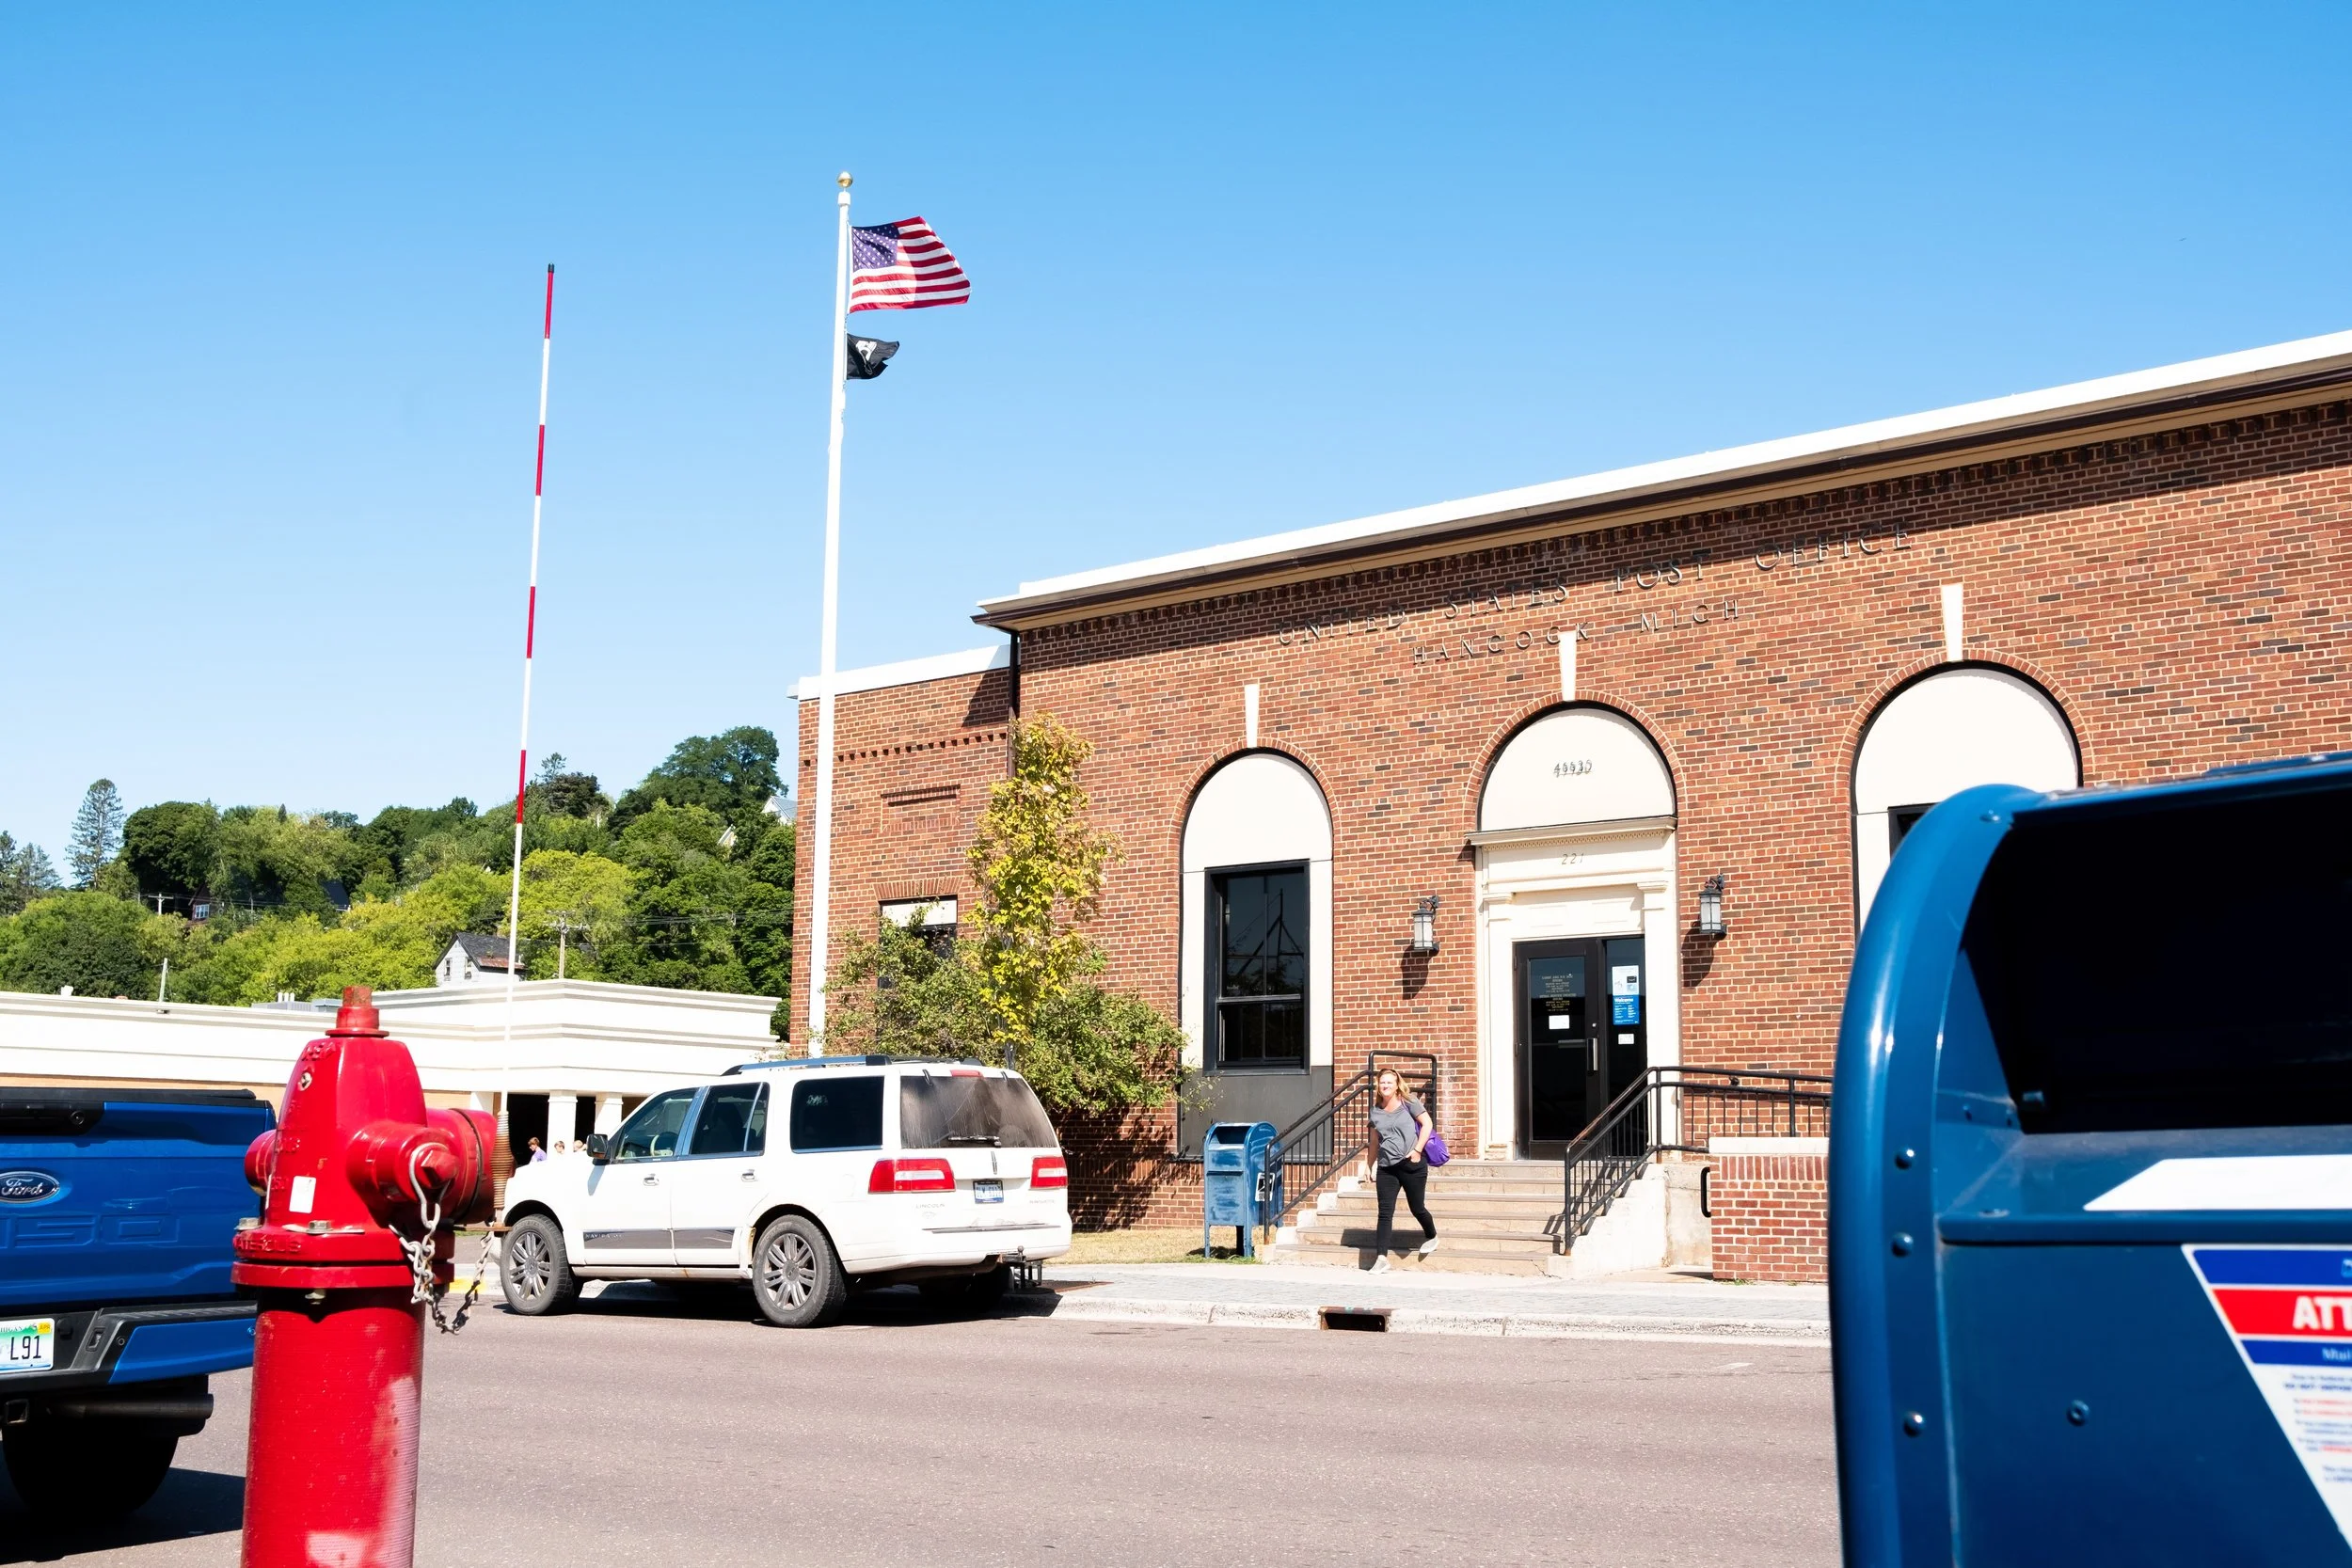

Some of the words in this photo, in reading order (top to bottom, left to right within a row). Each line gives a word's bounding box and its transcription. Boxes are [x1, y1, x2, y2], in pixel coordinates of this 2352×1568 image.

[1279, 605, 1406, 645] UNITED
[1444, 578, 1568, 618] STATES
[1614, 547, 1711, 593] POST
[1756, 522, 1912, 570] OFFICE
[1413, 622, 1589, 665] HANCOCK
[1640, 599, 1740, 632] MICH
[1562, 852, 1584, 864] 221
[1, 1178, 43, 1196] Ford
[10, 1335, 41, 1360] L91
